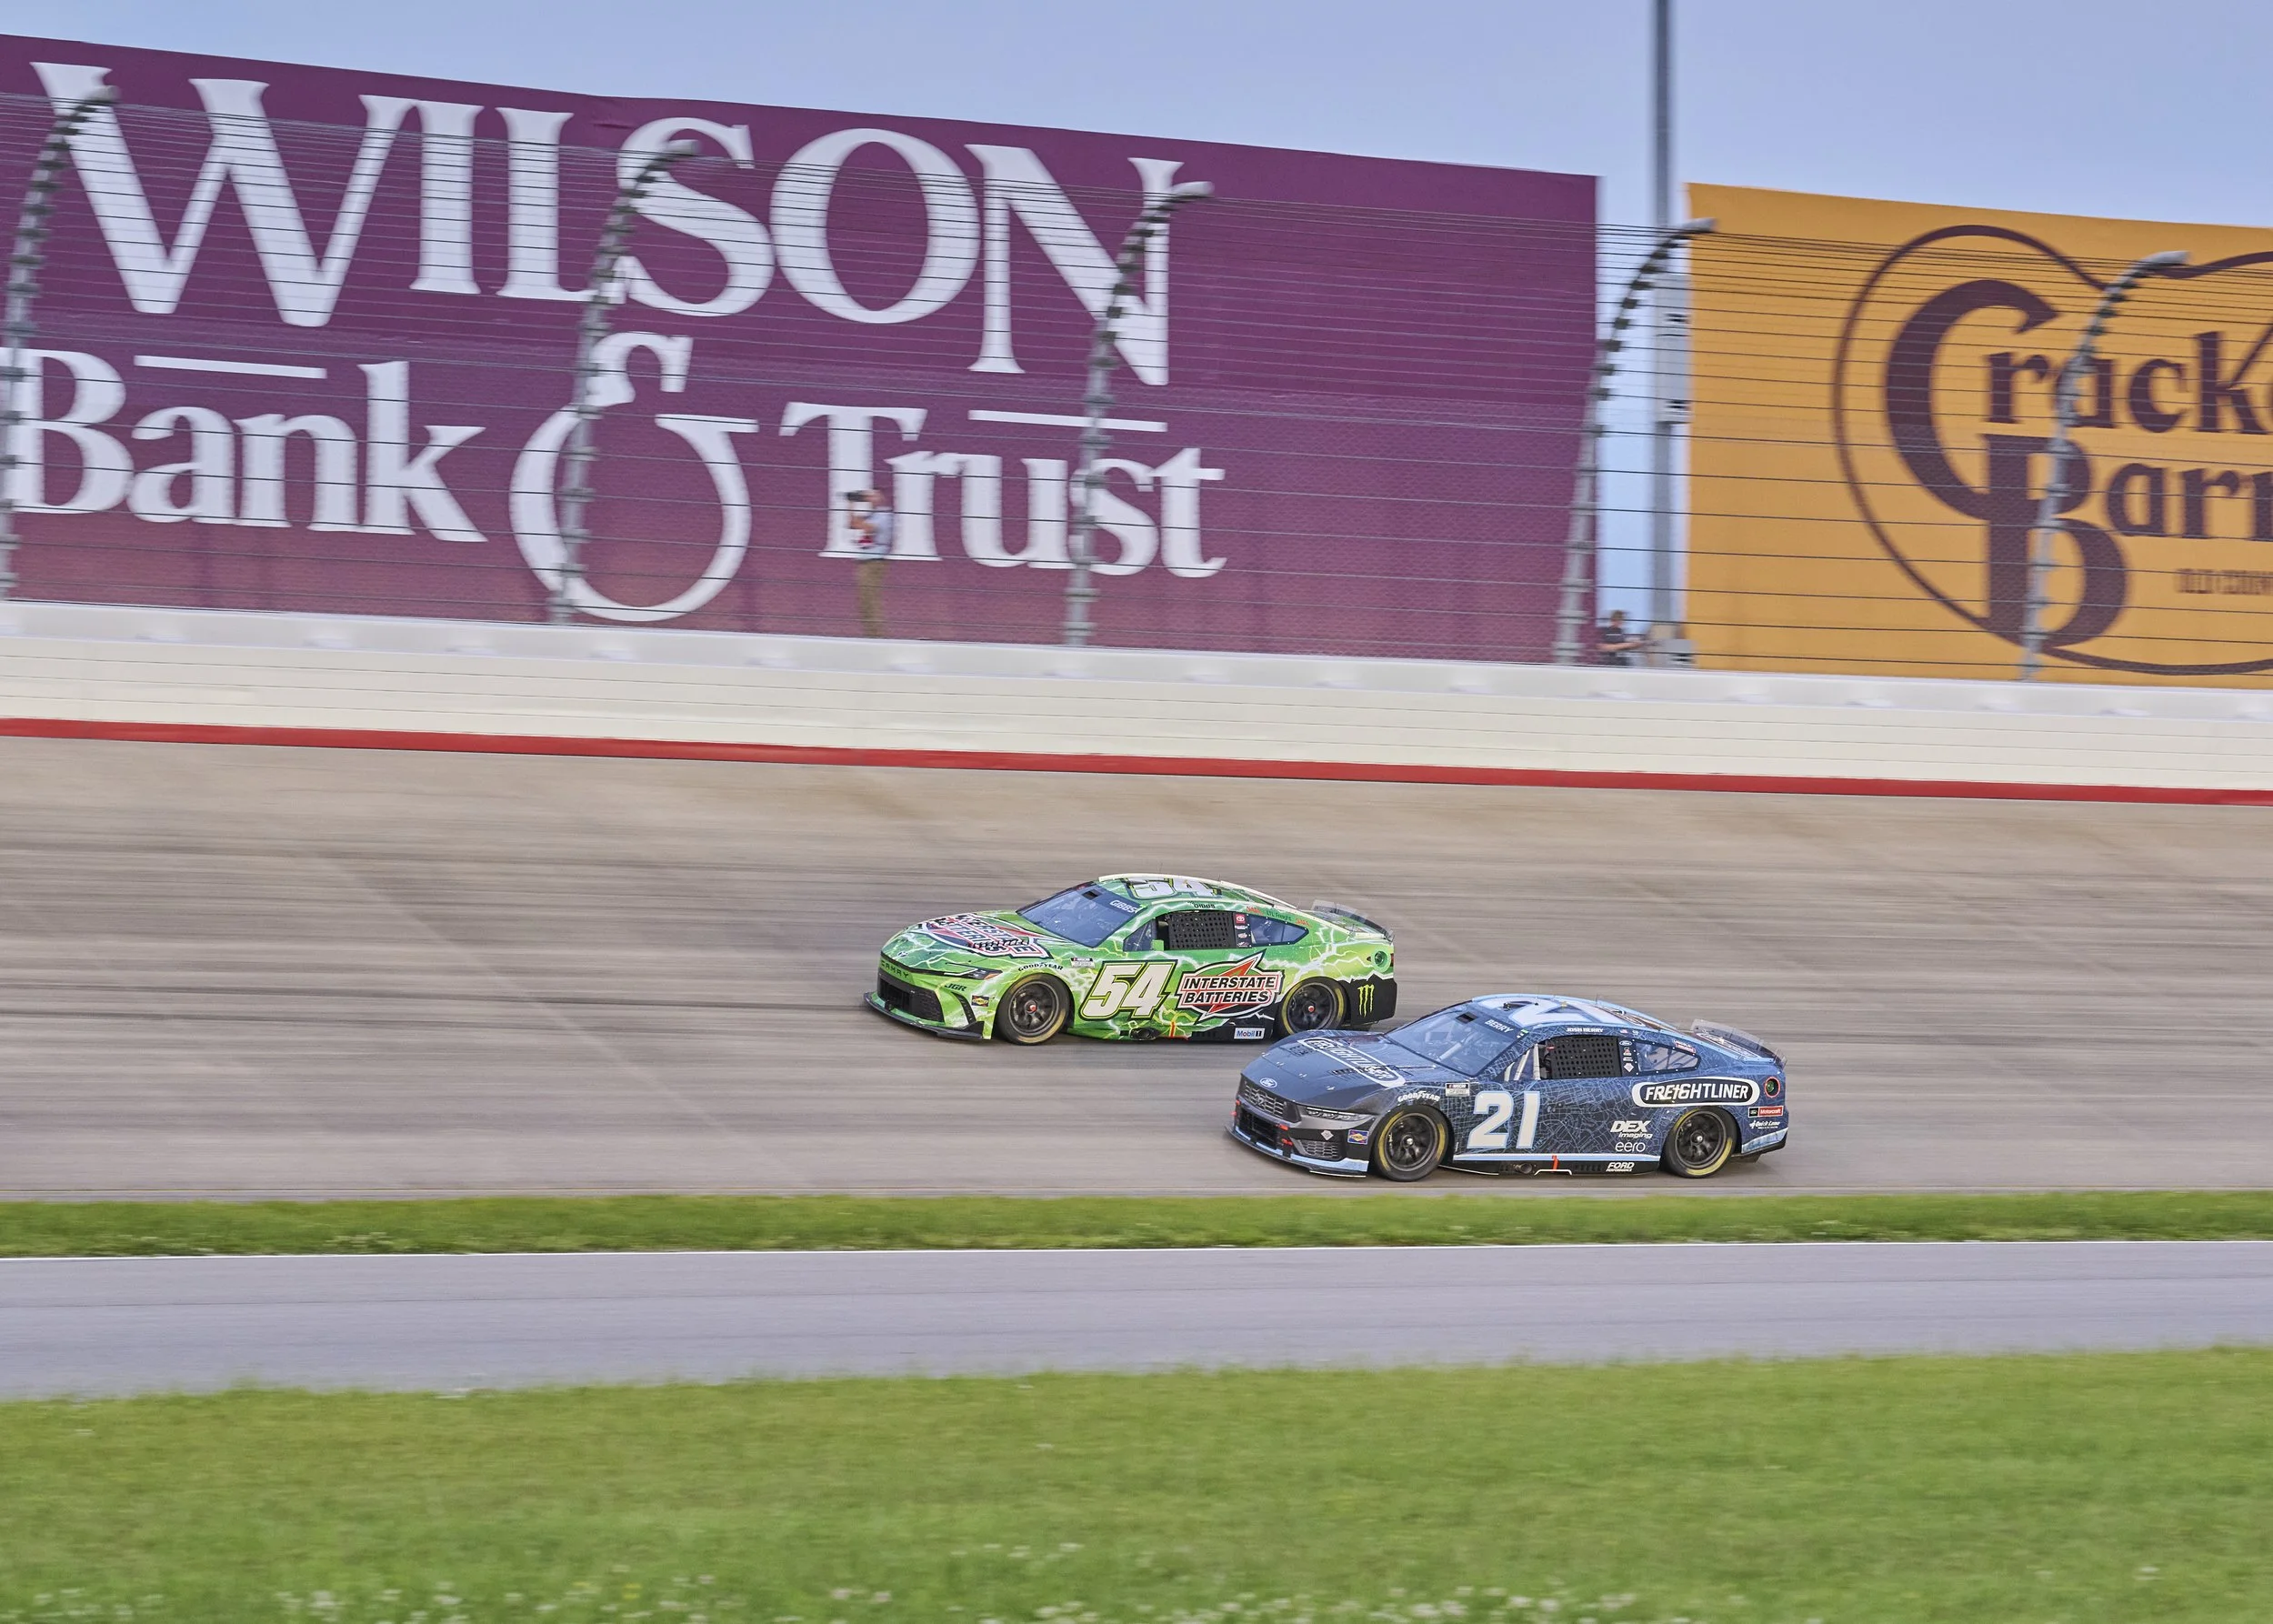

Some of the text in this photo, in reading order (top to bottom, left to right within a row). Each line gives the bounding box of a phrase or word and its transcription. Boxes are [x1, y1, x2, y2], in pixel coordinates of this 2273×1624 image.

[30, 62, 1184, 386] WILSON
[1884, 279, 2273, 522] Crack
[0, 347, 489, 543] Bank
[779, 401, 1227, 577] Trust
[1109, 899, 1138, 914] GIBBS
[1017, 961, 1065, 972] GOODYEAR
[944, 983, 967, 992] JGR
[1080, 961, 1177, 1019] 54
[1183, 977, 1277, 989] INTERSTATE
[1185, 990, 1269, 1003] BATTERIES
[1484, 1018, 1515, 1033] BERRY
[1397, 1090, 1440, 1102] GOODYEAR
[1643, 1082, 1749, 1102] FREIGHTLINER
[1467, 1090, 1540, 1148] 21
[1610, 1120, 1651, 1133] DEX
[1615, 1141, 1646, 1152] eero
